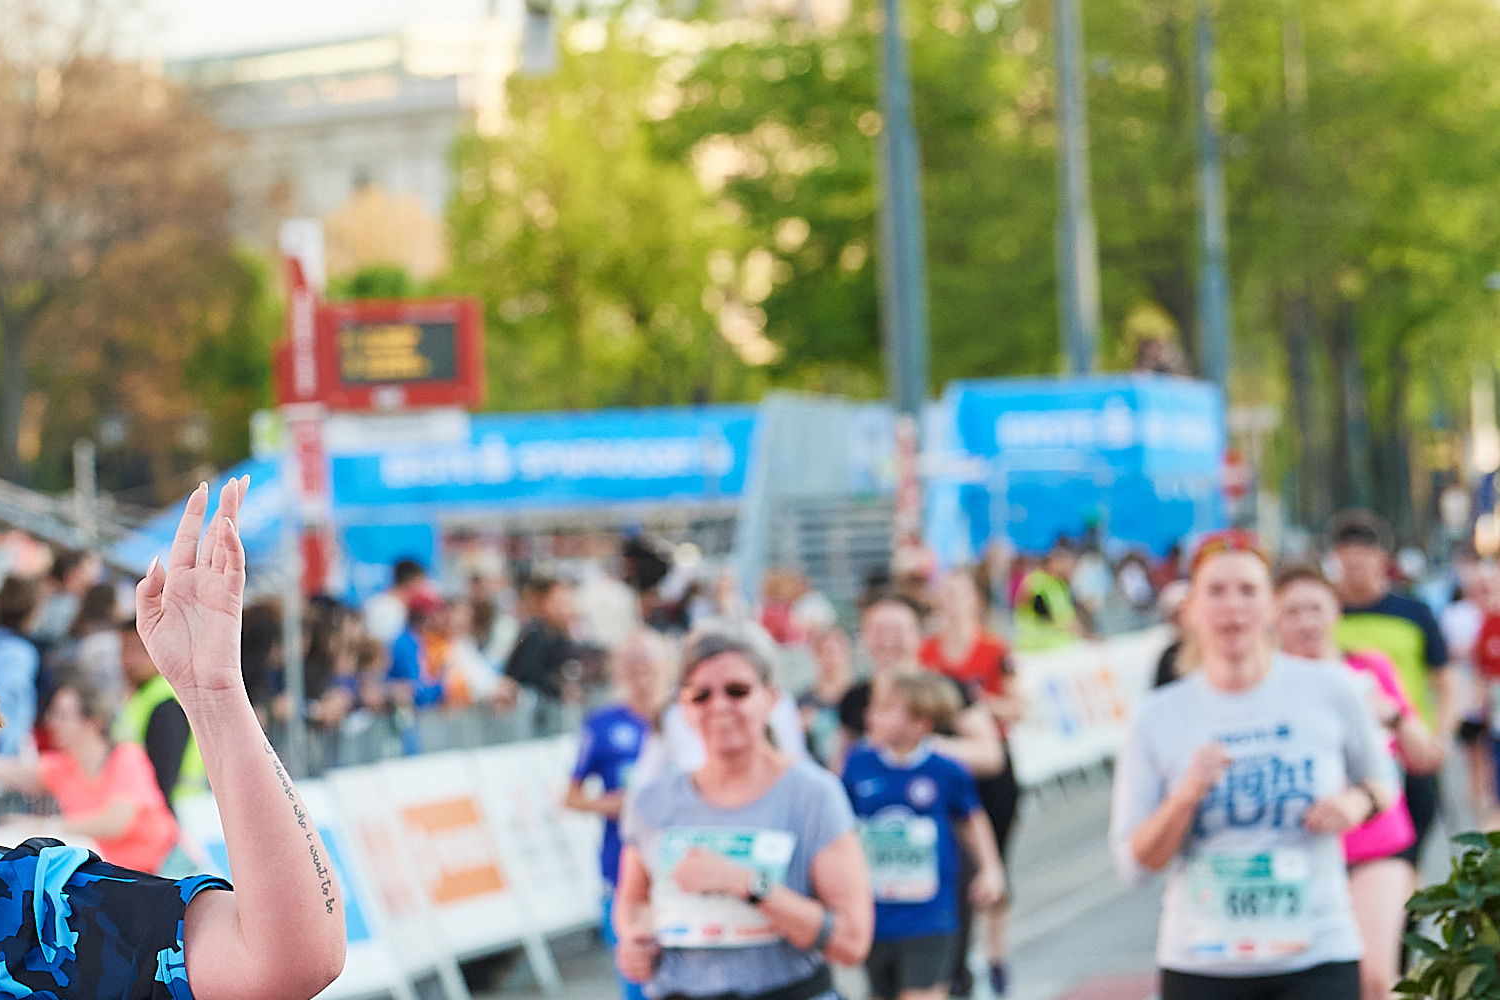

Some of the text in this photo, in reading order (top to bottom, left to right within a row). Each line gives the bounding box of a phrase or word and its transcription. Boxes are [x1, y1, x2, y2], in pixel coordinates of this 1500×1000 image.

[293, 804, 307, 830] who
[306, 832, 313, 841] i
[309, 844, 328, 879] want
[321, 878, 332, 897] to
[325, 897, 335, 915] be
